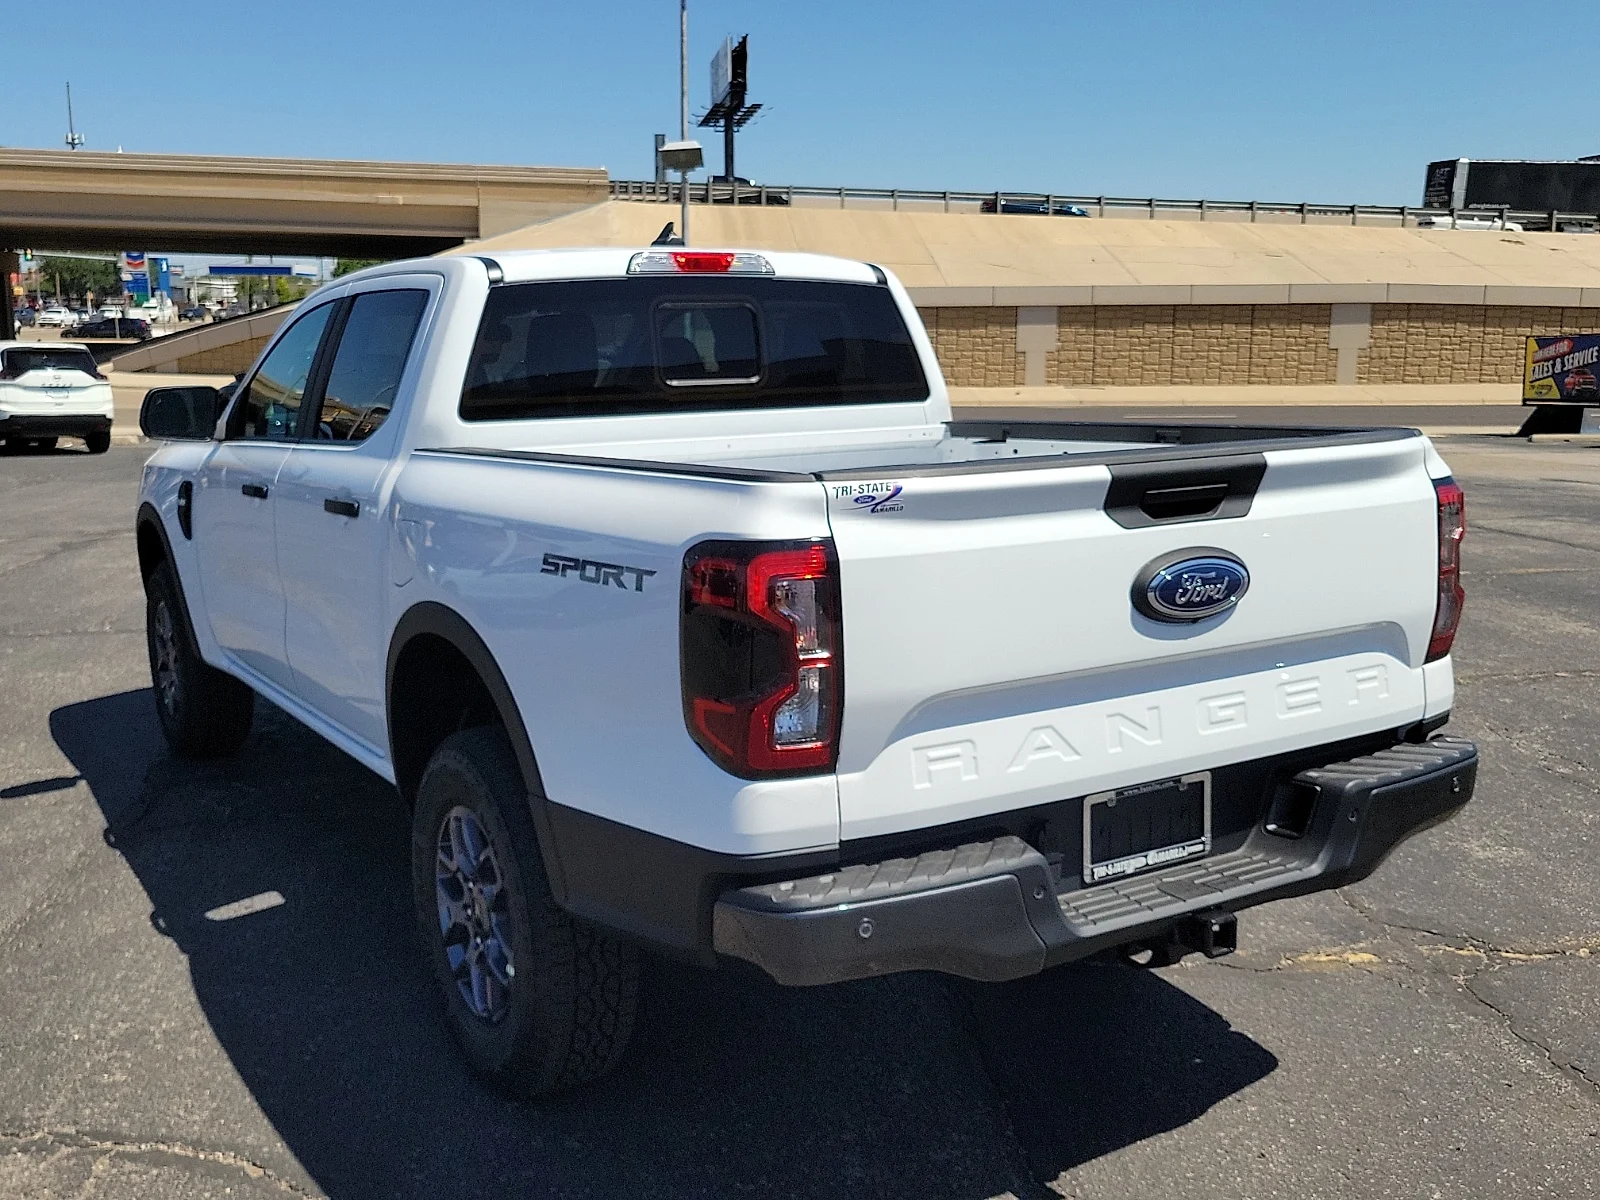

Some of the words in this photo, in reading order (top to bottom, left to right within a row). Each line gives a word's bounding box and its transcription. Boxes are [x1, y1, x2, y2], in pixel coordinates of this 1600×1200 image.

[1554, 358, 1562, 373] &
[1563, 346, 1599, 371] SERVICE
[833, 482, 892, 499] TRI-STATE
[540, 553, 658, 592] SPORT
[1175, 571, 1229, 605] Ford
[911, 663, 1390, 789] RANGER
